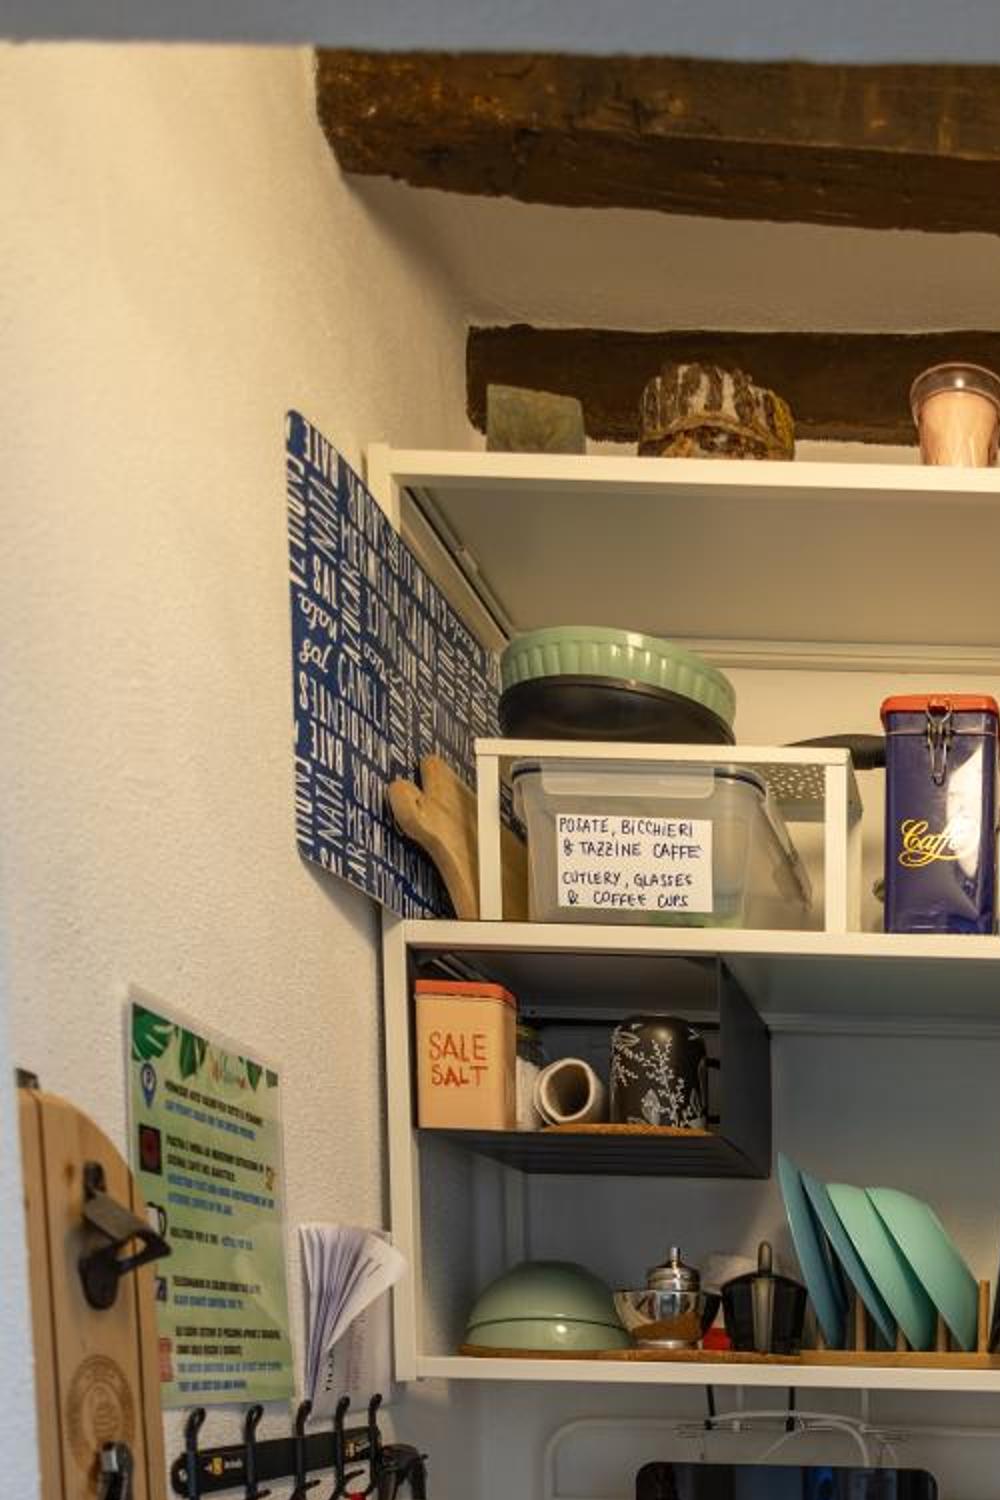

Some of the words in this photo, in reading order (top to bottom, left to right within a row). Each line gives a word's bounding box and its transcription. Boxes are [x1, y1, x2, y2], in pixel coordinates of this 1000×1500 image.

[621, 820, 694, 838] BICCHIERI
[579, 841, 642, 858] TAZZINE
[632, 873, 692, 889] GLASSES
[593, 891, 648, 907] COFFEE
[656, 893, 689, 908] CUPS
[429, 1031, 488, 1063] SALE
[431, 1063, 489, 1088] SALT
